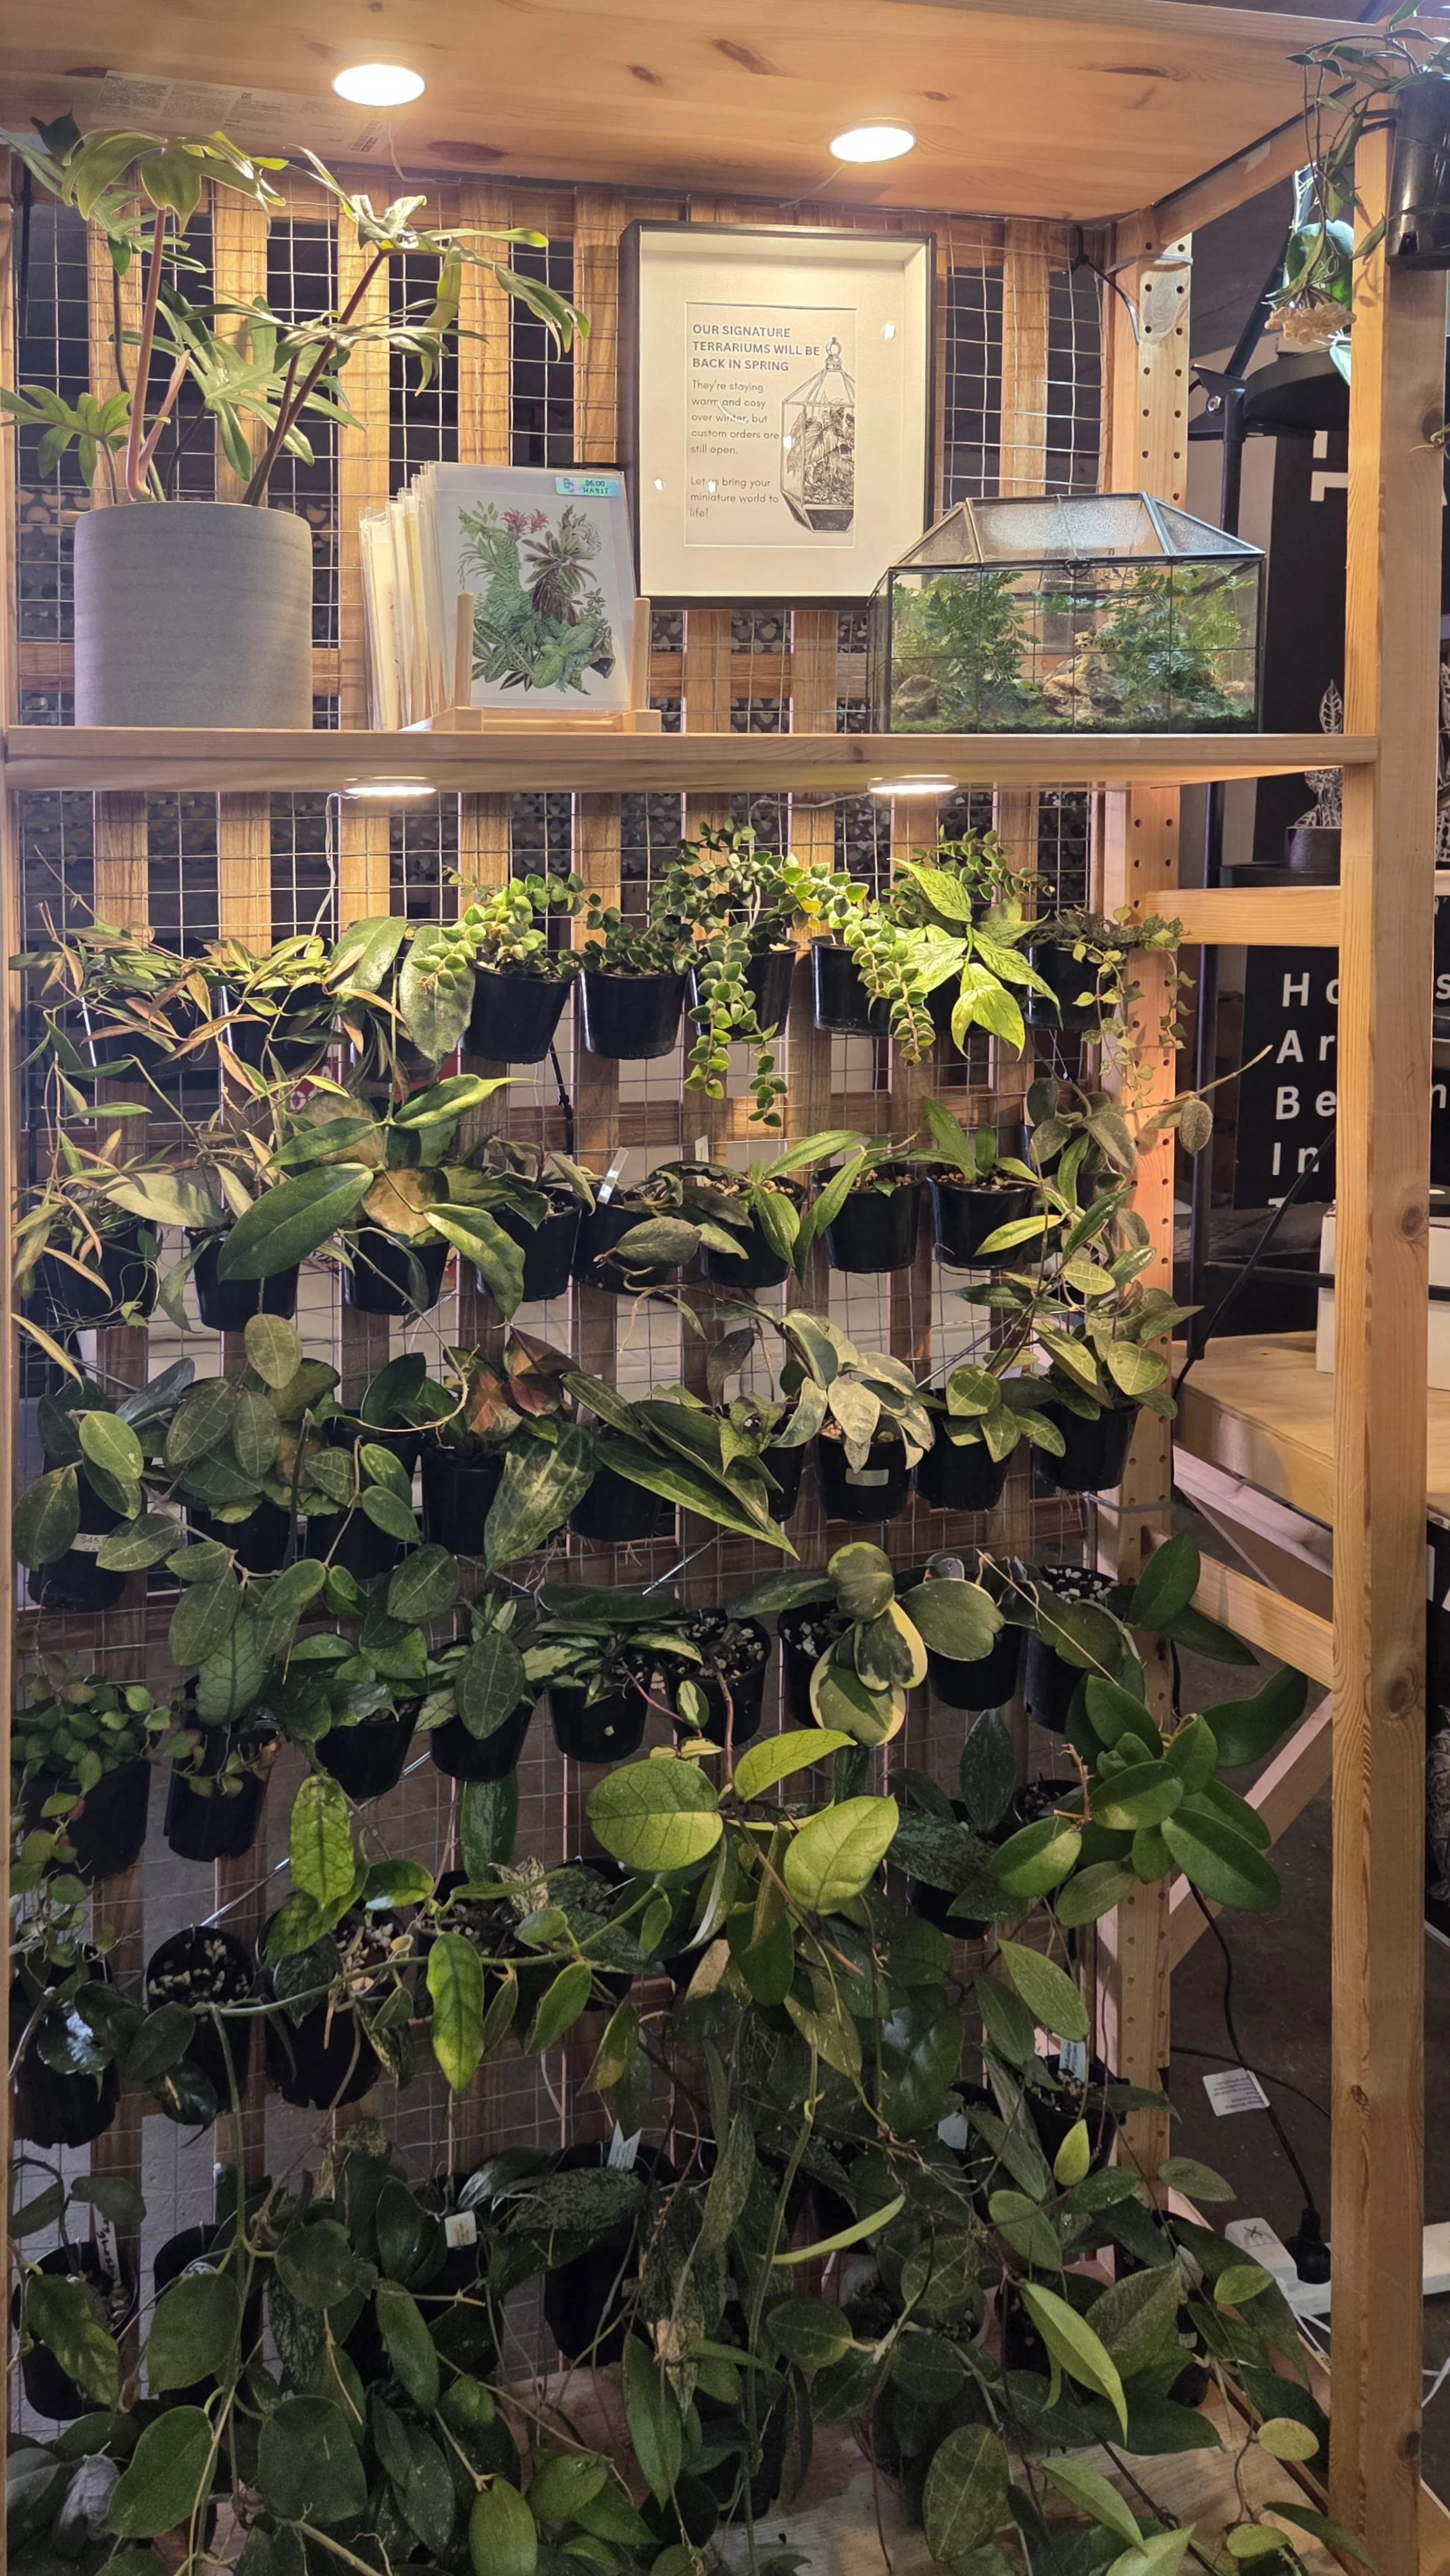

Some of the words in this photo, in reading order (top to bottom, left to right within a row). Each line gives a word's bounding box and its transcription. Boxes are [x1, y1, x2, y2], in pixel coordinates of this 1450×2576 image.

[693, 324, 720, 335] OUR
[722, 326, 791, 338] SIGNATURE
[692, 341, 771, 353] TERRARIUMS
[774, 345, 802, 355] WILL
[805, 346, 820, 355] BE
[693, 358, 726, 368] BACK
[729, 360, 741, 369] IN
[745, 360, 789, 371] SPRING
[692, 380, 726, 392] They're
[729, 382, 764, 394] staying
[722, 397, 741, 406] and
[744, 400, 766, 410] cosy
[751, 414, 768, 423] but
[691, 430, 727, 438] custom
[730, 429, 761, 439] orders
[691, 444, 707, 453] still
[710, 447, 739, 456] open.
[585, 479, 605, 487] $6.00
[691, 476, 705, 485] Let
[722, 476, 747, 489] bring
[749, 480, 771, 489] your
[691, 493, 736, 502] miniature
[739, 493, 766, 503] world
[769, 495, 779, 503] to
[690, 507, 709, 518] life!
